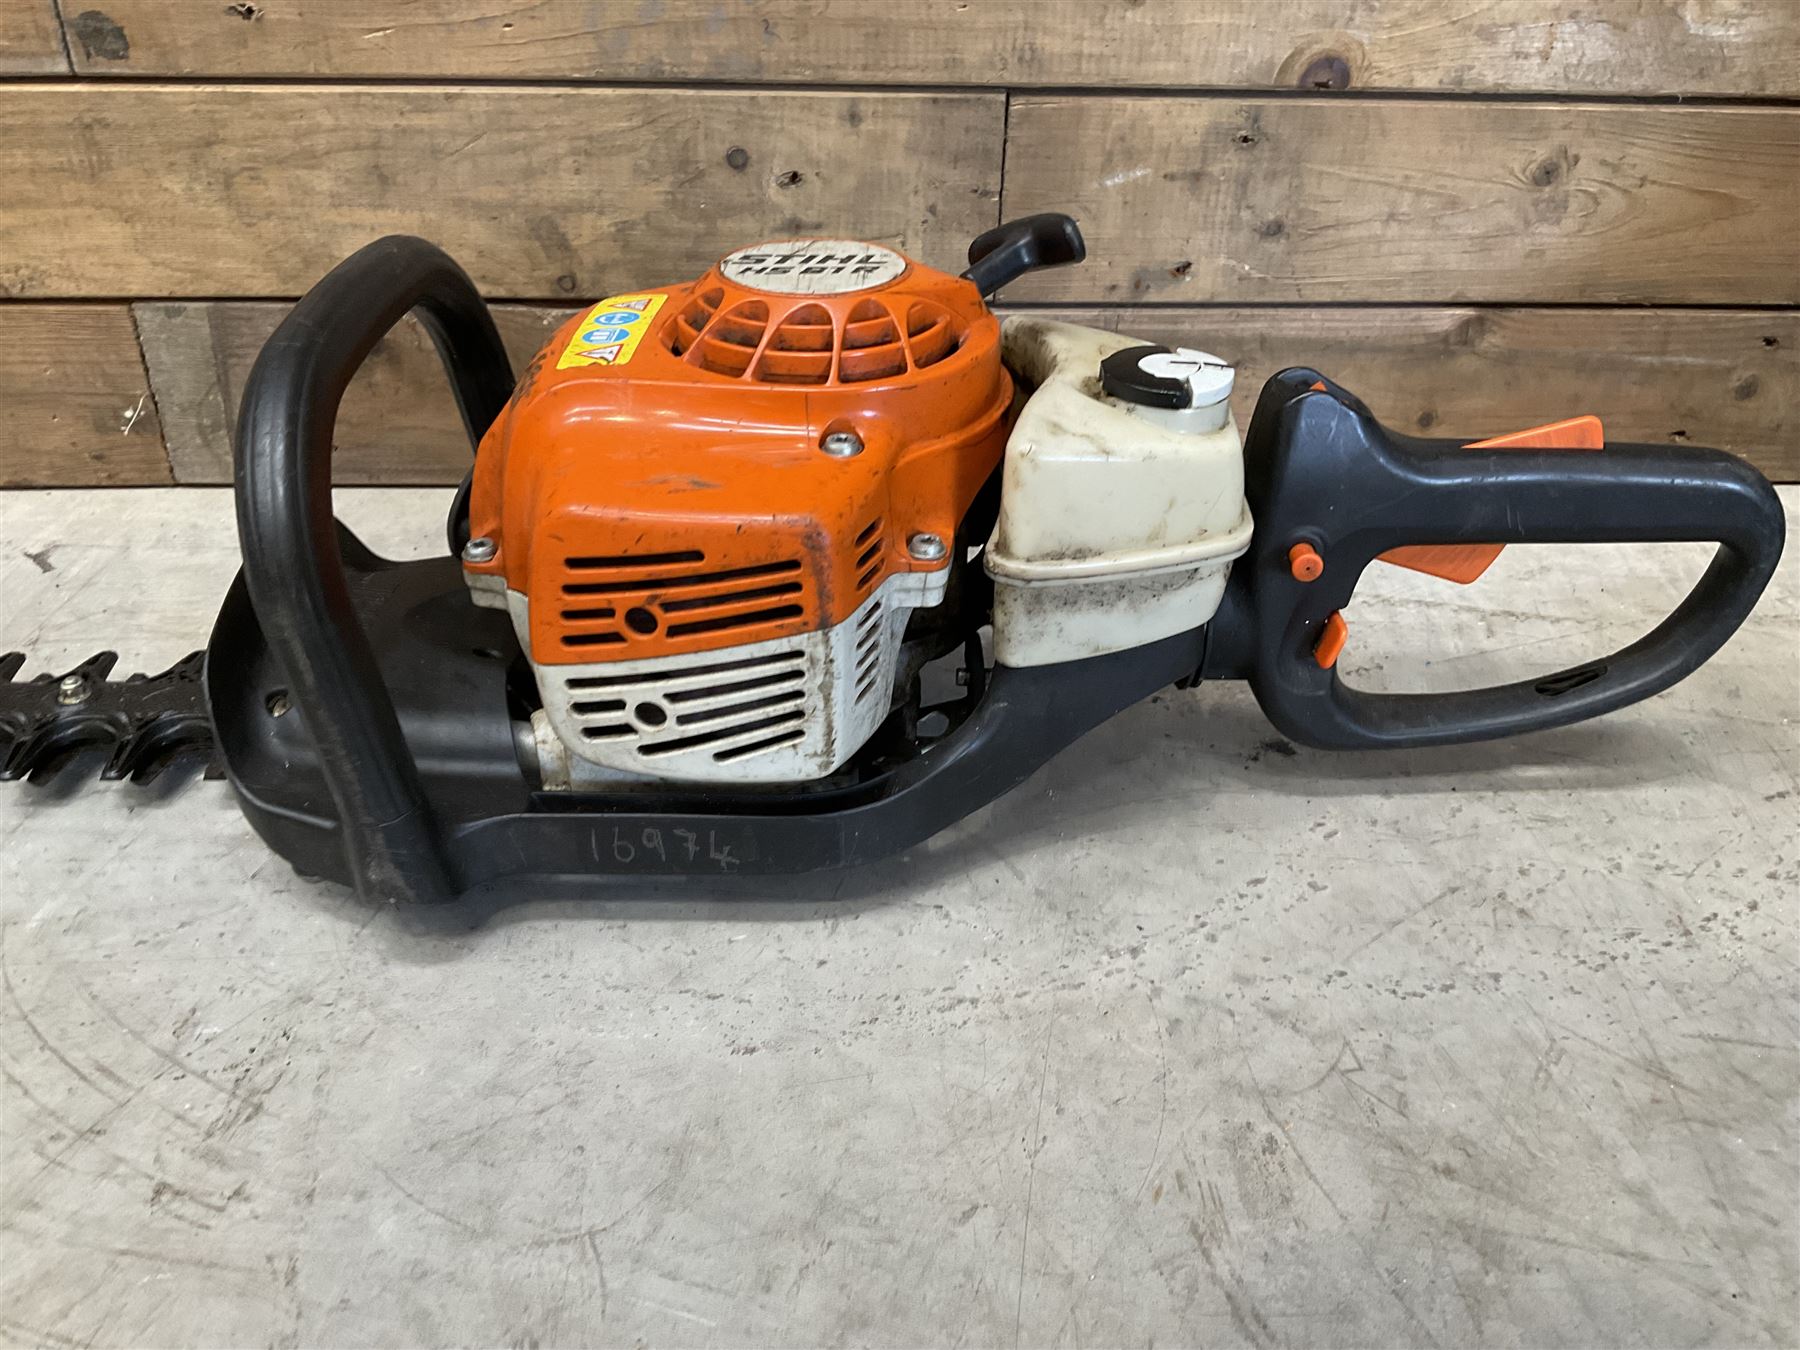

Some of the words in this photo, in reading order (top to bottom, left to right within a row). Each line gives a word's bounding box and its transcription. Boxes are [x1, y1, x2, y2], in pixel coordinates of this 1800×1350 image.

[731, 254, 888, 265] STIHL
[738, 266, 795, 275] HS
[590, 826, 741, 872] 16974
